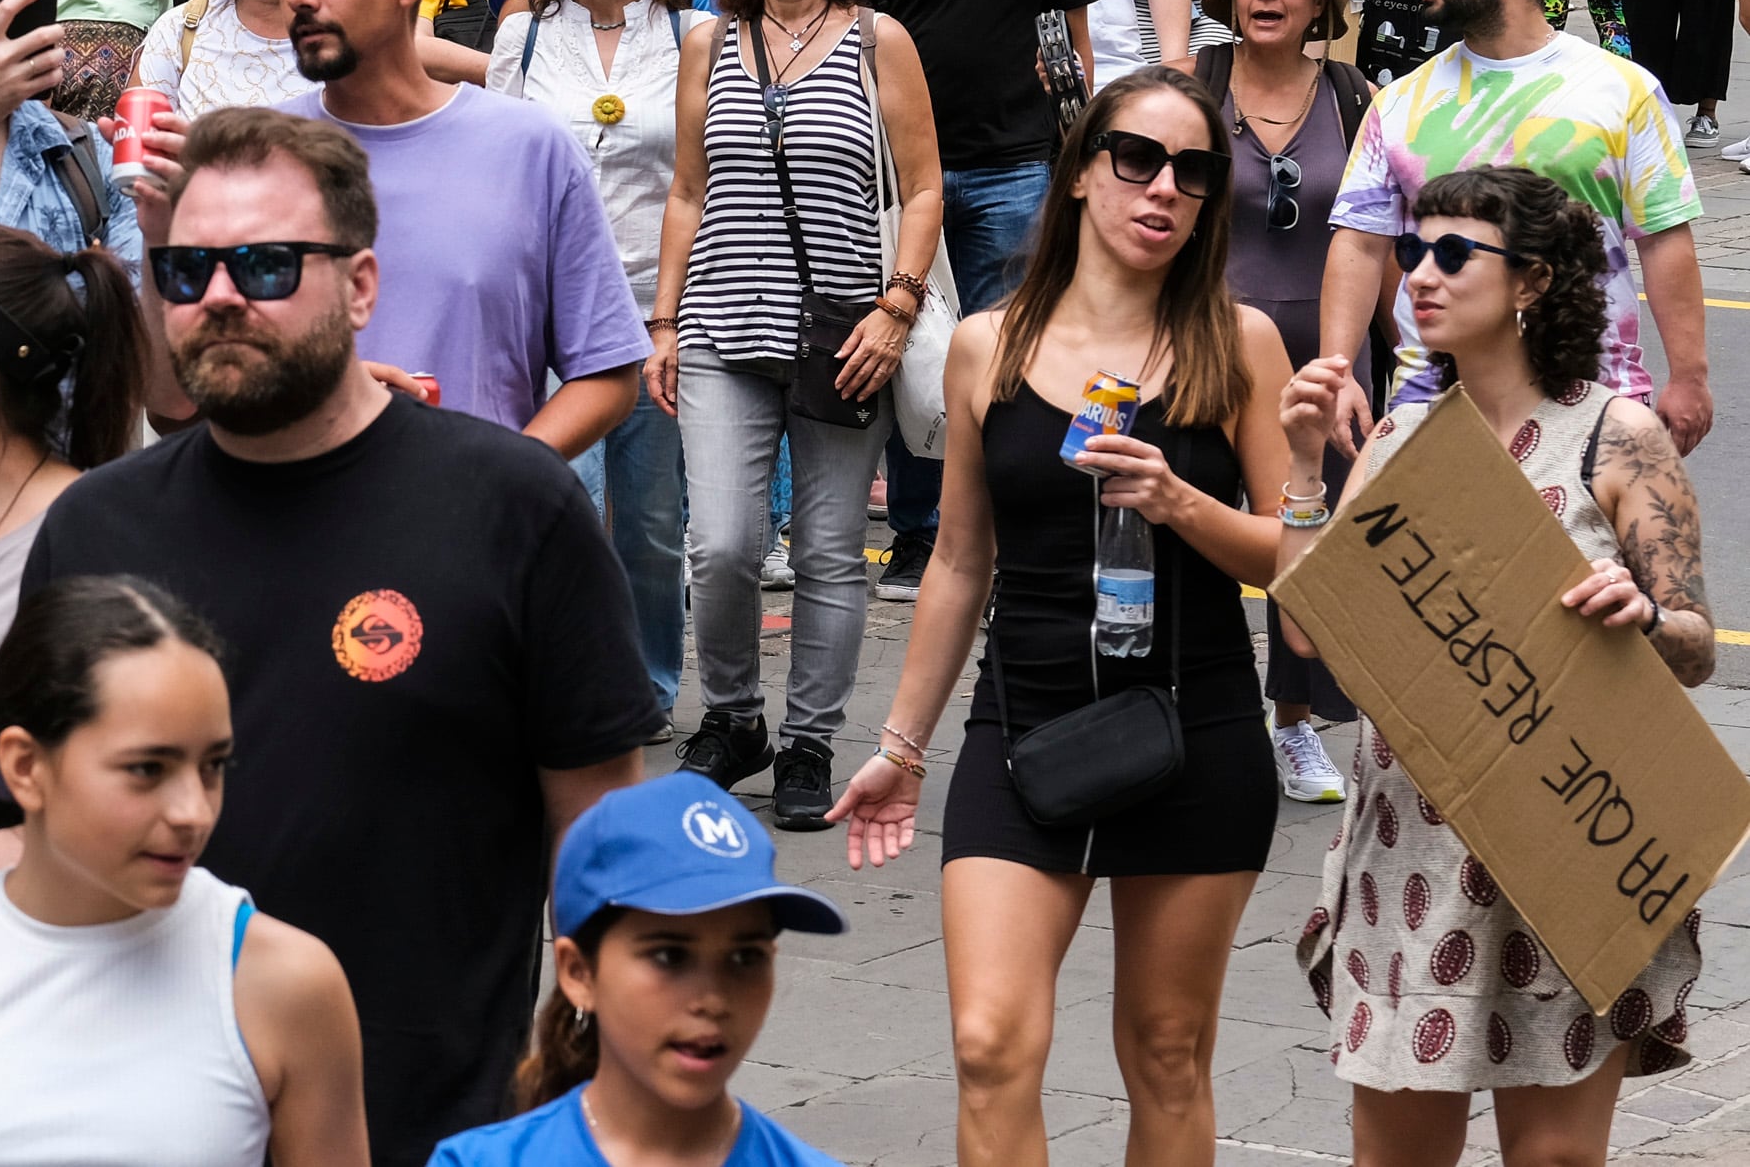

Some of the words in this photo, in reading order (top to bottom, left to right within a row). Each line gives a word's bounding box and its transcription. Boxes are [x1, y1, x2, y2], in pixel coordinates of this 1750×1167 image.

[1383, 0, 1408, 10] eyes
[1079, 402, 1127, 431] ARIUS
[1352, 502, 1555, 745] RESPETEN
[1541, 736, 1634, 846] QUE
[694, 813, 741, 848] M
[1616, 837, 1689, 927] PA
